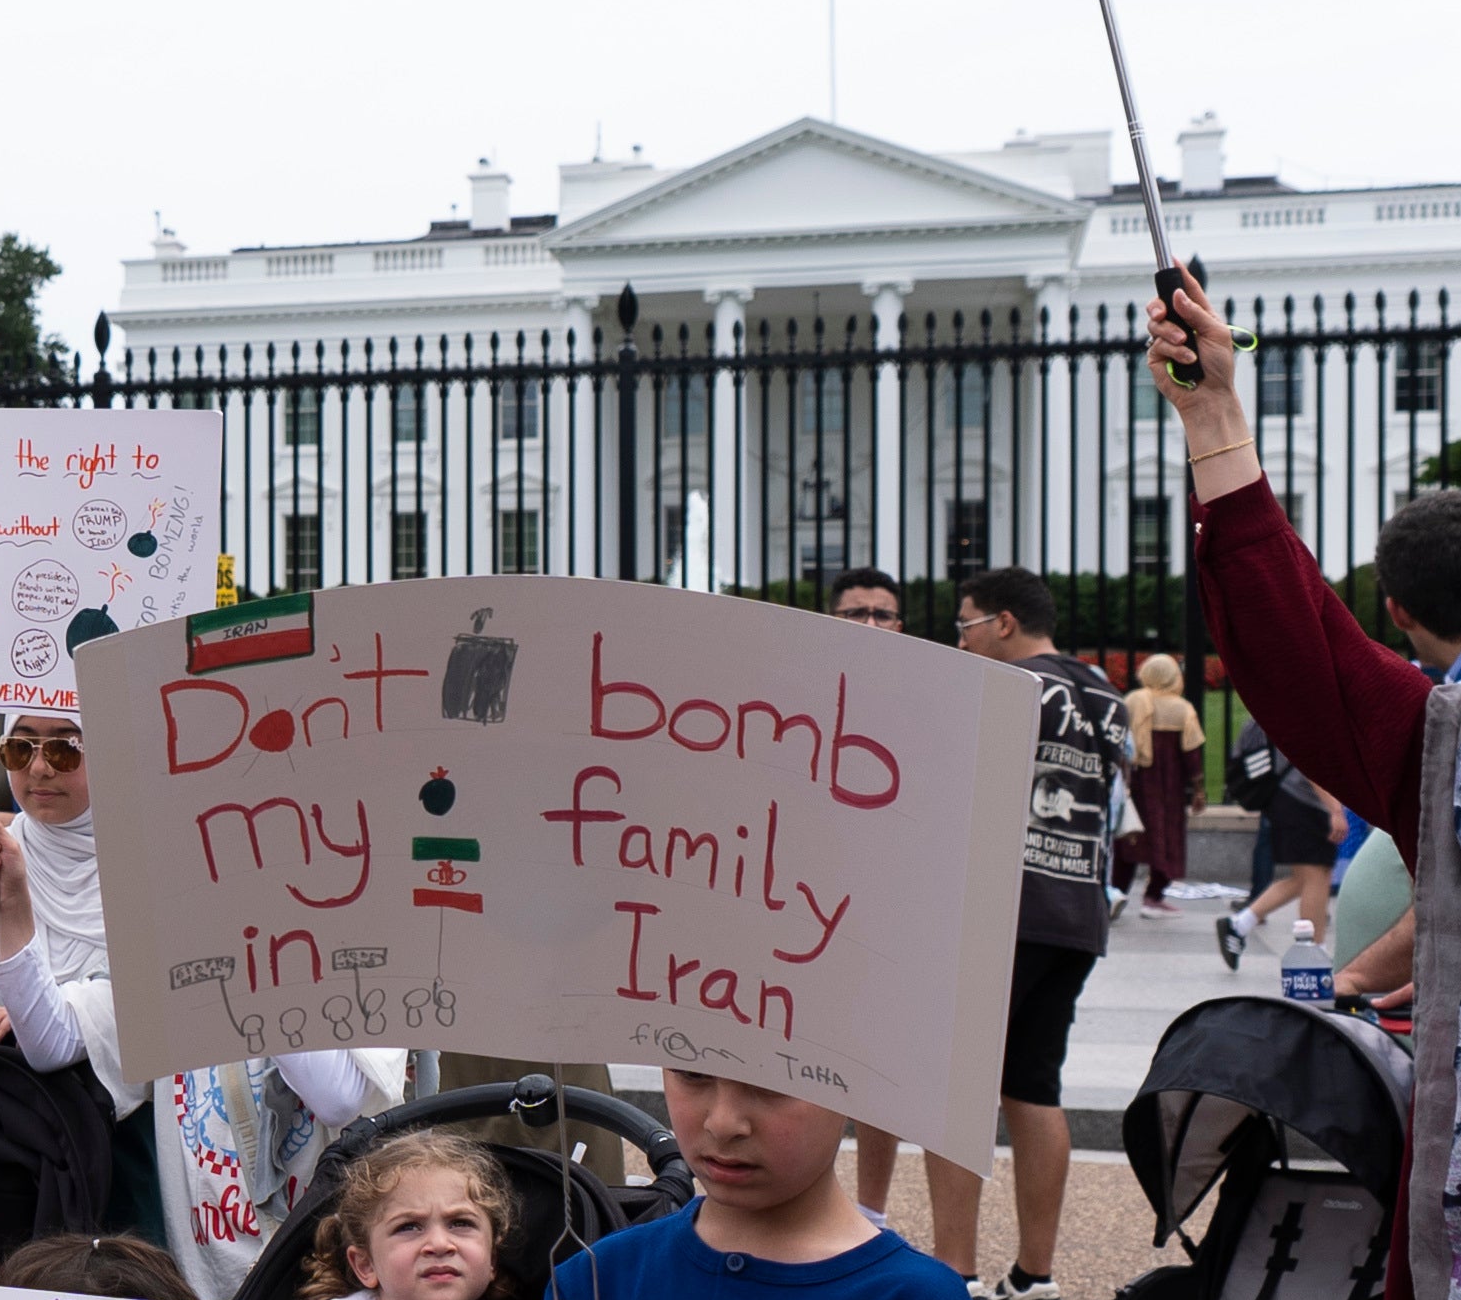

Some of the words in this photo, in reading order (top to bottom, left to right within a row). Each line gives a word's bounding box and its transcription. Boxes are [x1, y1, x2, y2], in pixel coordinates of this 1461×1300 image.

[15, 438, 50, 471] the
[65, 444, 118, 489] right
[132, 445, 160, 469] to
[79, 514, 122, 528] TRUMP
[223, 618, 268, 640] IRAN
[588, 630, 901, 810] bomb
[195, 794, 374, 910] my
[540, 766, 851, 964] family
[243, 925, 324, 994] in
[614, 901, 796, 1042] Iran
